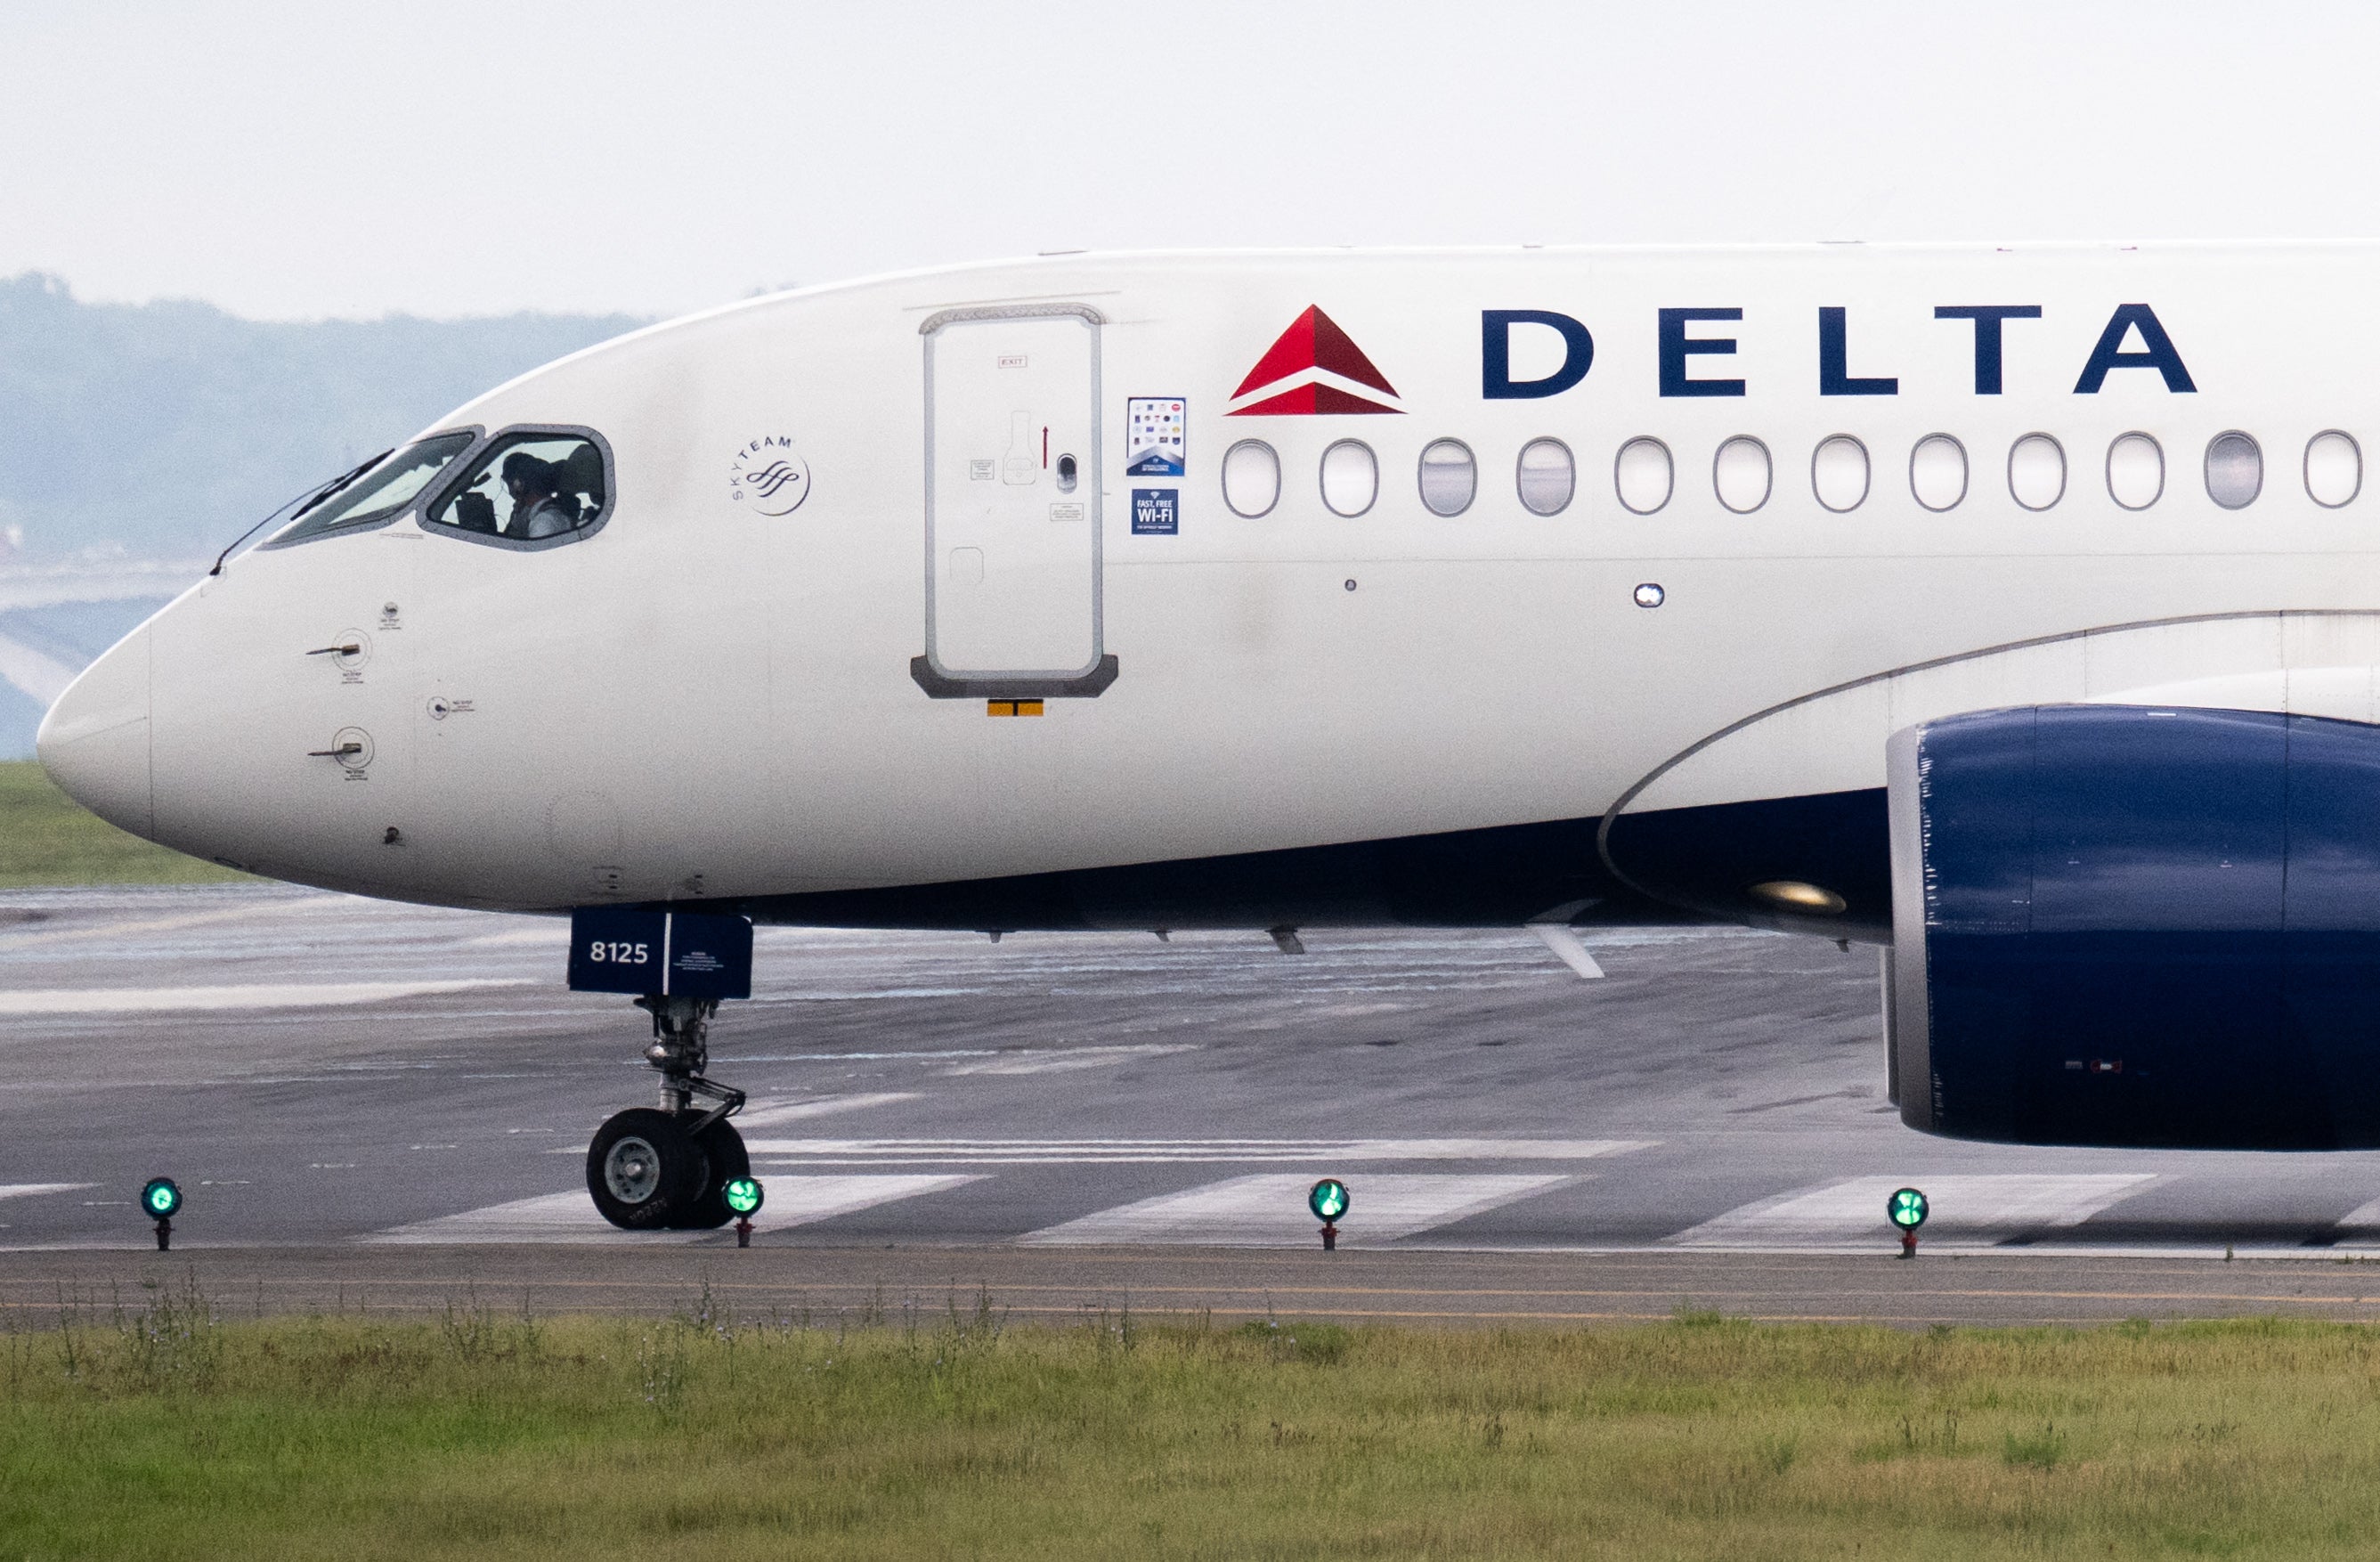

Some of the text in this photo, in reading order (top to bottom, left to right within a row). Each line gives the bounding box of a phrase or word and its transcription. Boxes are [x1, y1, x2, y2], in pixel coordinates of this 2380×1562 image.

[1482, 304, 2198, 399] DELTA
[1001, 358, 1023, 367] EXIT
[730, 435, 792, 500] SKYTEAM
[1156, 500, 1173, 508] FREE
[1137, 508, 1173, 523] WI-FI
[589, 941, 648, 964] 8125
